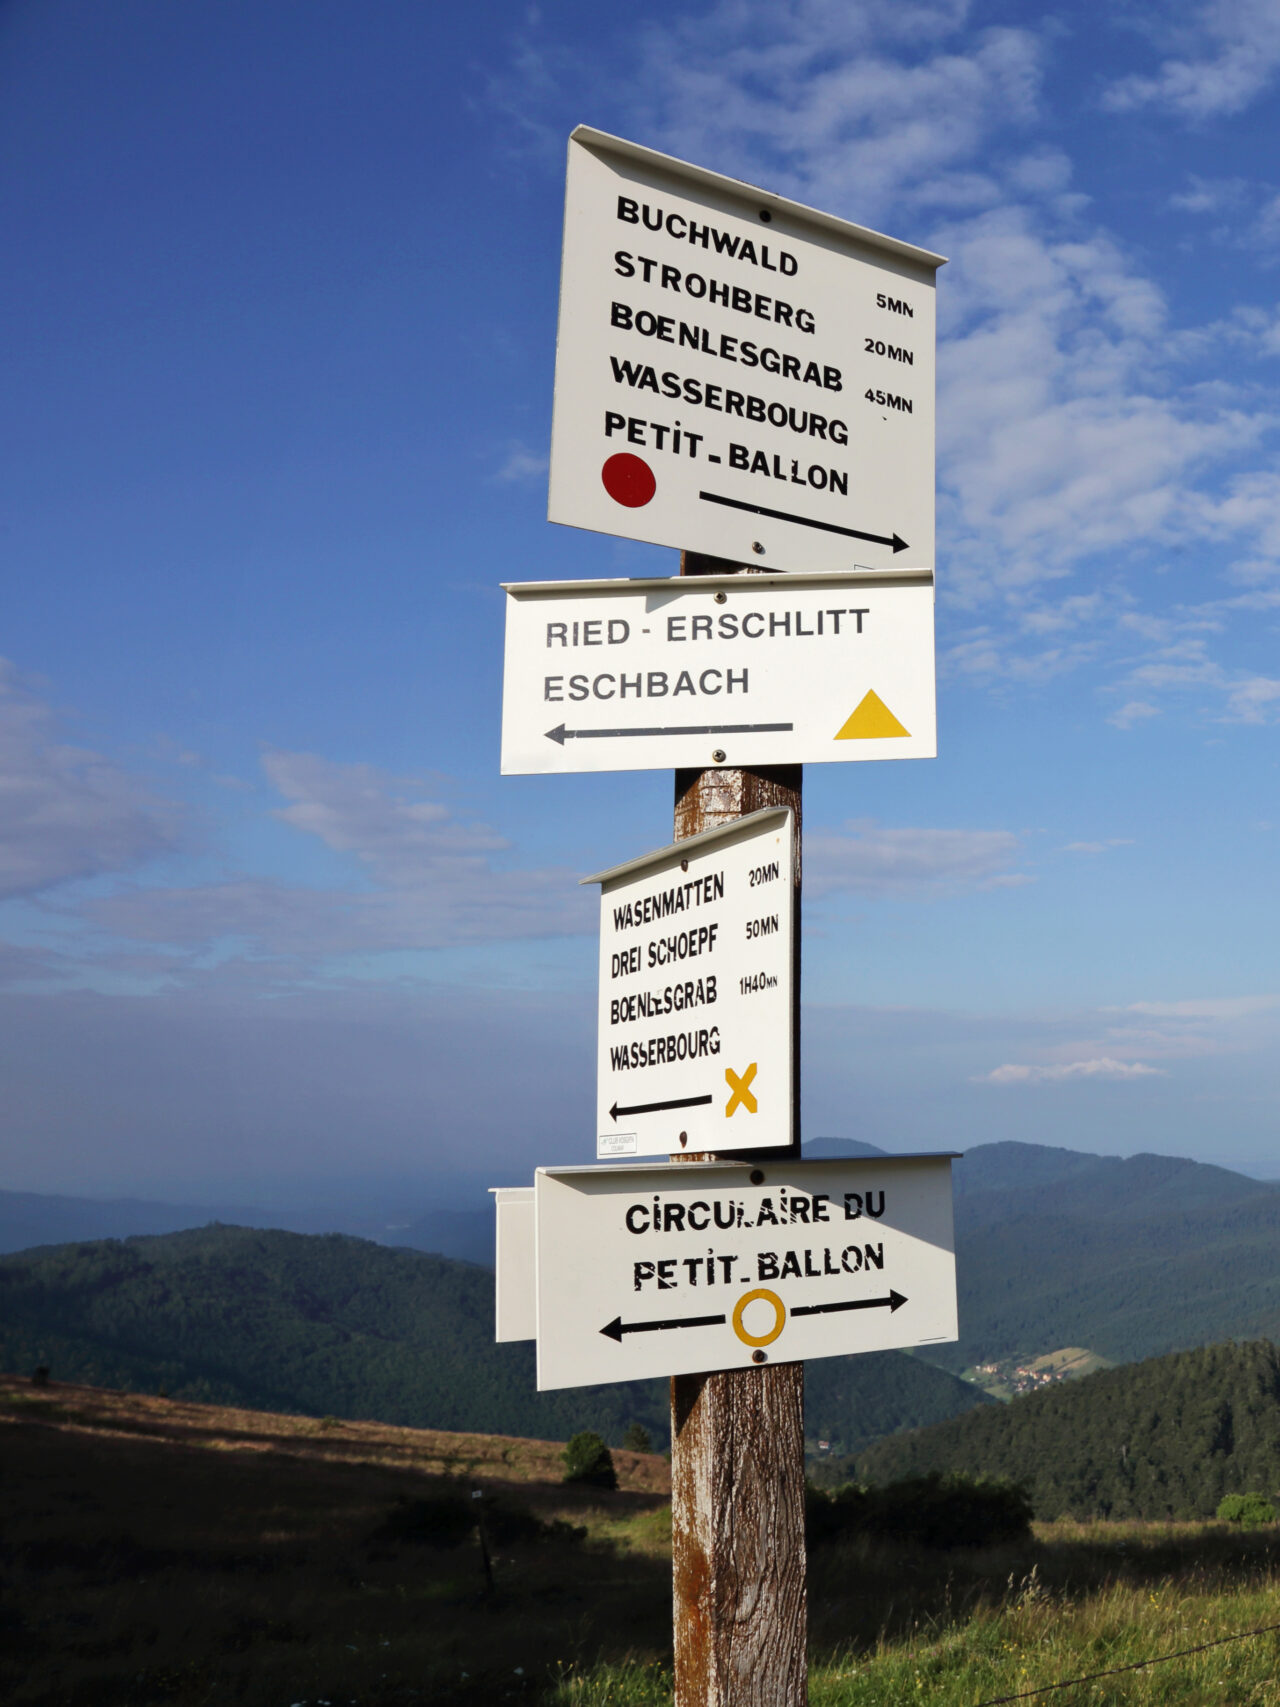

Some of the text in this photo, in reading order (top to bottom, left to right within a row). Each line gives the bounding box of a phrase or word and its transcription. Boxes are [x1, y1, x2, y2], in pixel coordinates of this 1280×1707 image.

[617, 196, 913, 317] BUCHWALD 5MN
[615, 251, 913, 365] STROHBERG 20MN
[611, 302, 912, 413] BOENLESGRAB 45MN
[610, 356, 848, 446] WASSERBOURG
[547, 620, 629, 647] RIED
[668, 609, 869, 641] ERSCHLITT
[545, 669, 748, 701] ESCHBACH
[613, 862, 778, 930] WASENMATTEN 20MN
[612, 915, 778, 978] DREI SCHOEPF 50MN
[610, 976, 717, 1024] BOENLESGRAB
[610, 1026, 720, 1071] WASSERBOURG
[844, 1191, 885, 1219] DU
